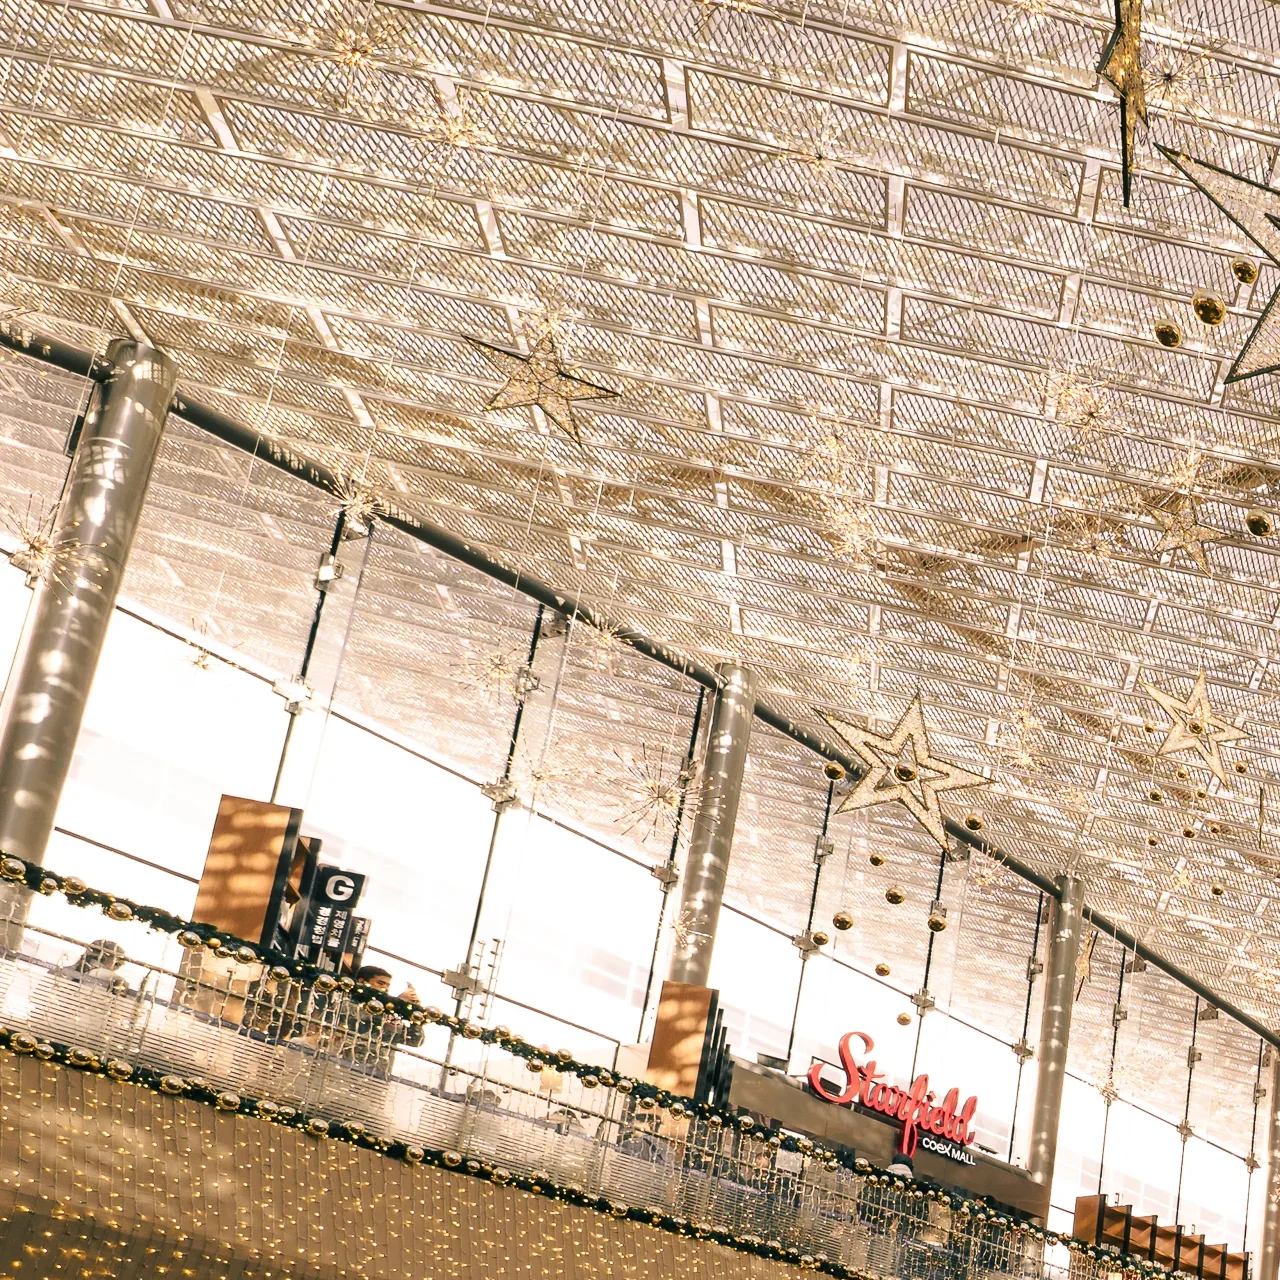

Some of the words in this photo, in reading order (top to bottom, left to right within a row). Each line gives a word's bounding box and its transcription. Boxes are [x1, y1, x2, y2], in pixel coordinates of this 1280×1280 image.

[325, 875, 355, 901] G
[807, 1031, 978, 1158] Starfield
[951, 1147, 976, 1166] MALL
